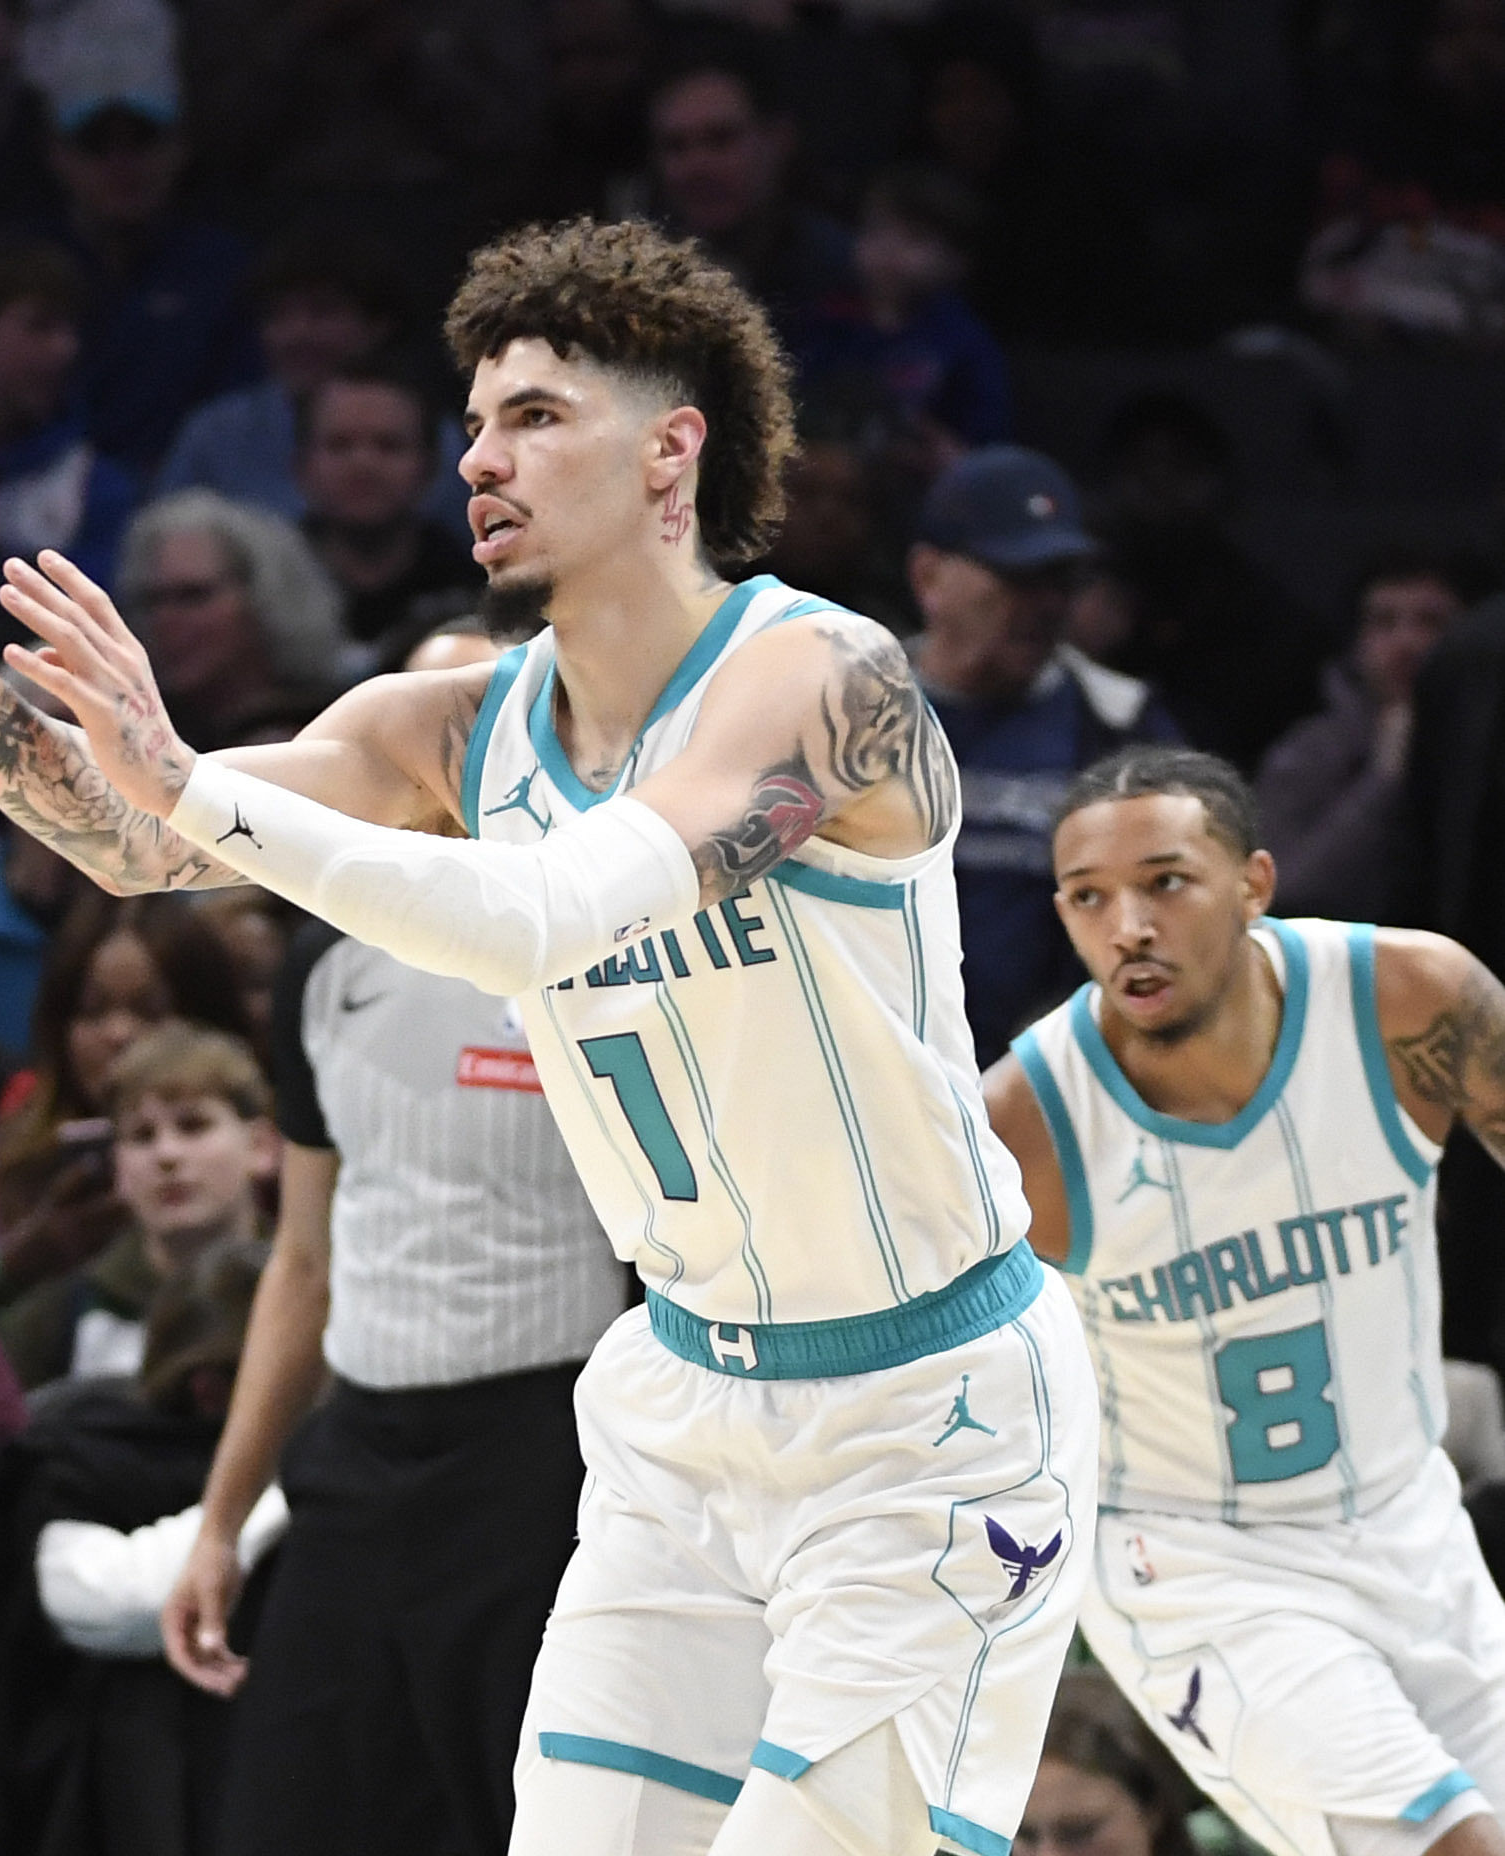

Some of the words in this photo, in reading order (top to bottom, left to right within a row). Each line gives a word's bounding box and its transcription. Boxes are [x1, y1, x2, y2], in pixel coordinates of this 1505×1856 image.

[576, 1030, 699, 1203] 1
[1098, 1193, 1409, 1323] CHARLOTTE
[1213, 1318, 1342, 1485] 8
